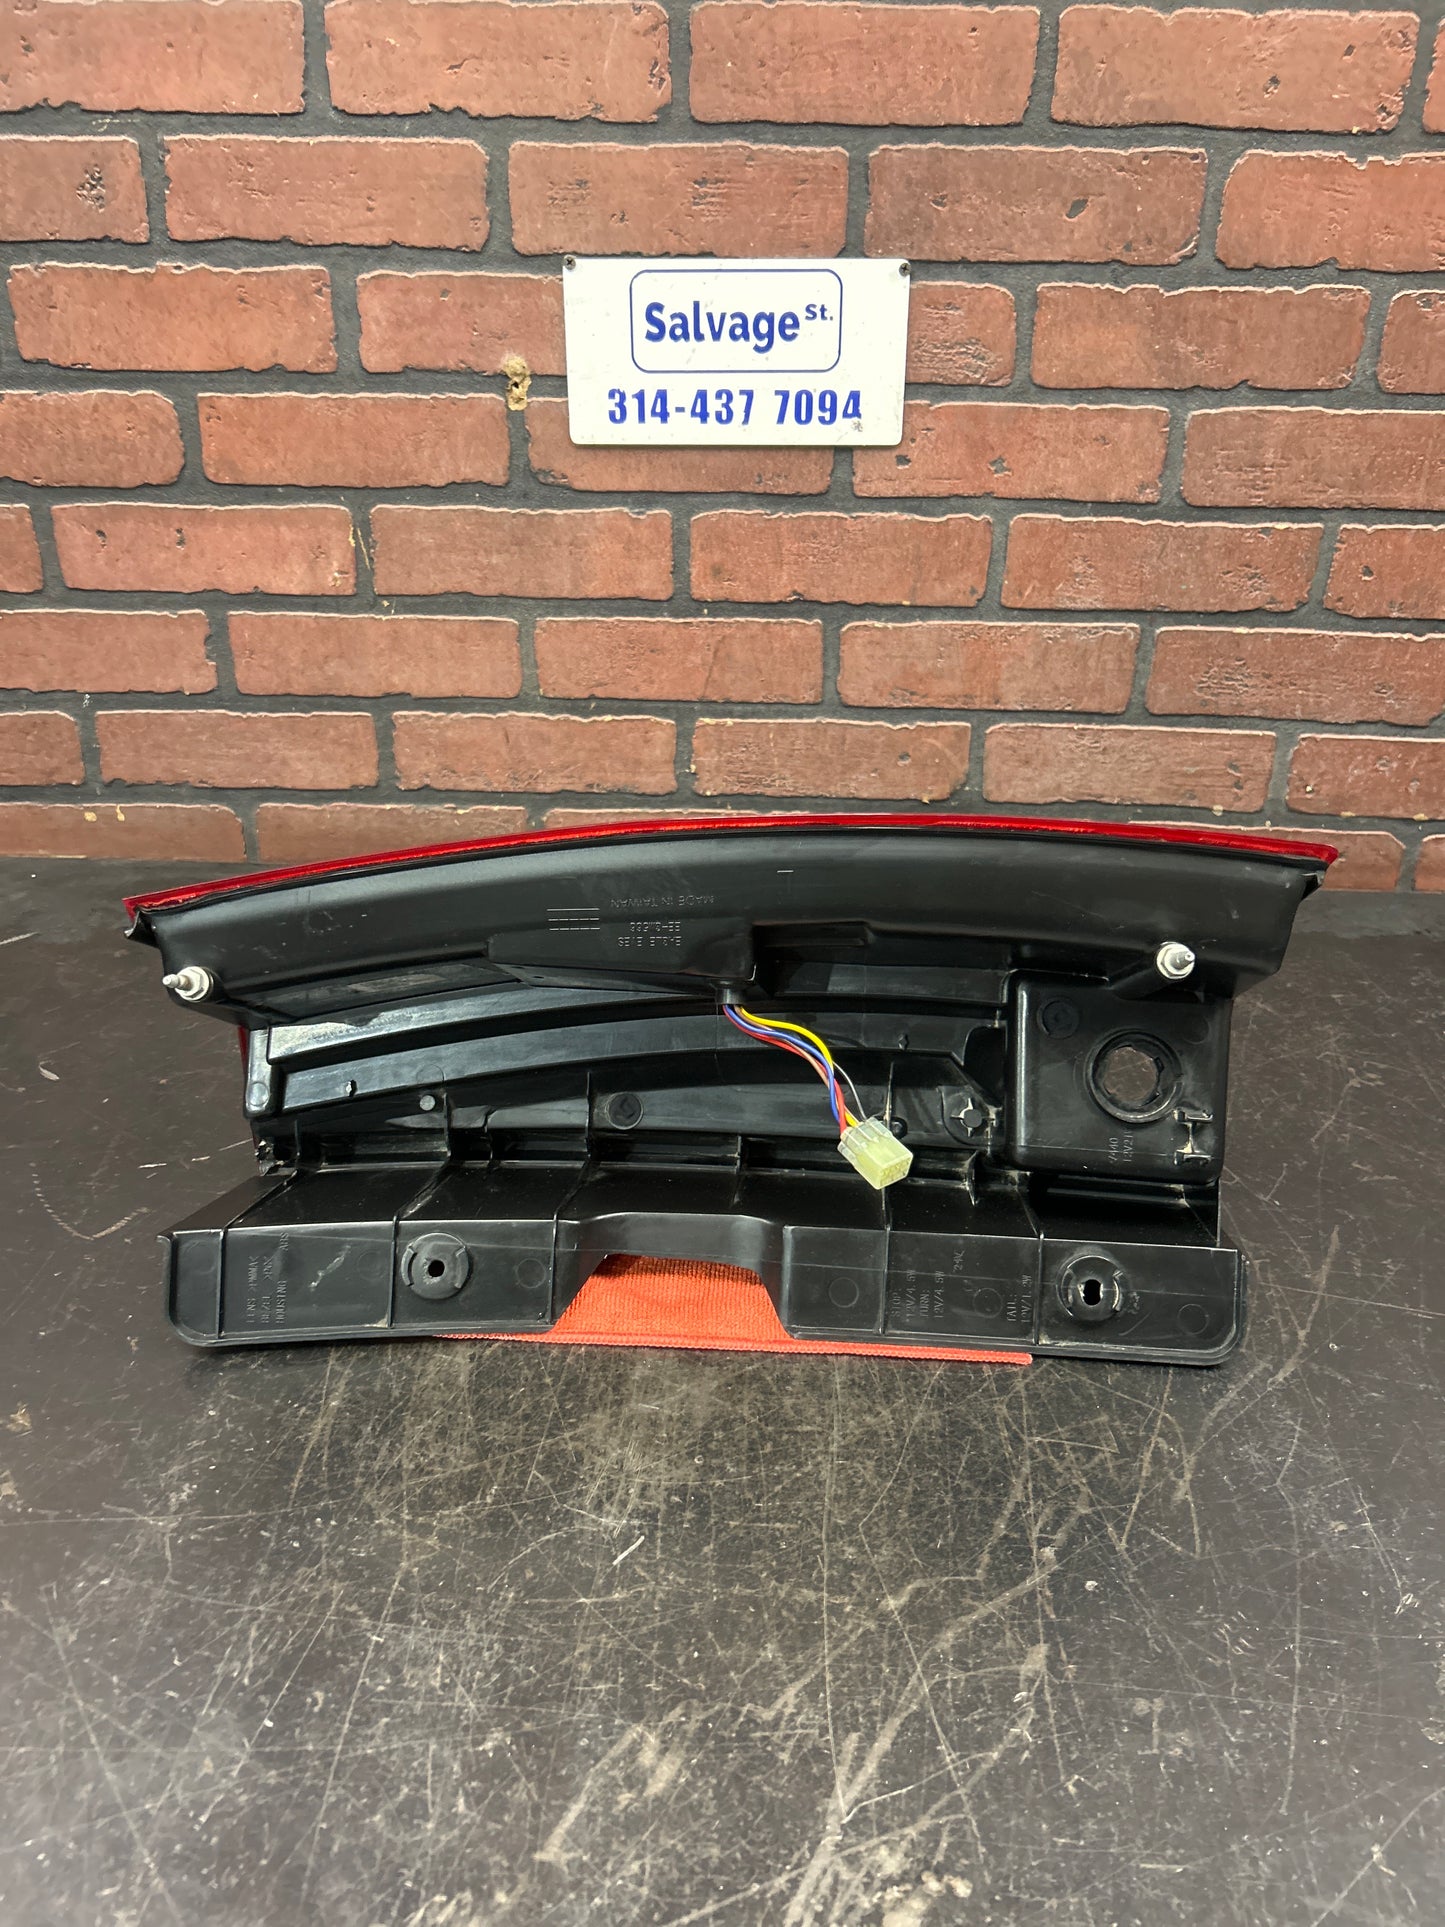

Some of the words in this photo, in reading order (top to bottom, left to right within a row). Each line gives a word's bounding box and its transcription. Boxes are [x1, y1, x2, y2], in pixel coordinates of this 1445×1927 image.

[645, 301, 800, 353] Salvage
[805, 304, 834, 321] St.
[608, 388, 754, 425] 314-437
[774, 389, 862, 425] 7094
[275, 1280, 287, 1324] HOUSING
